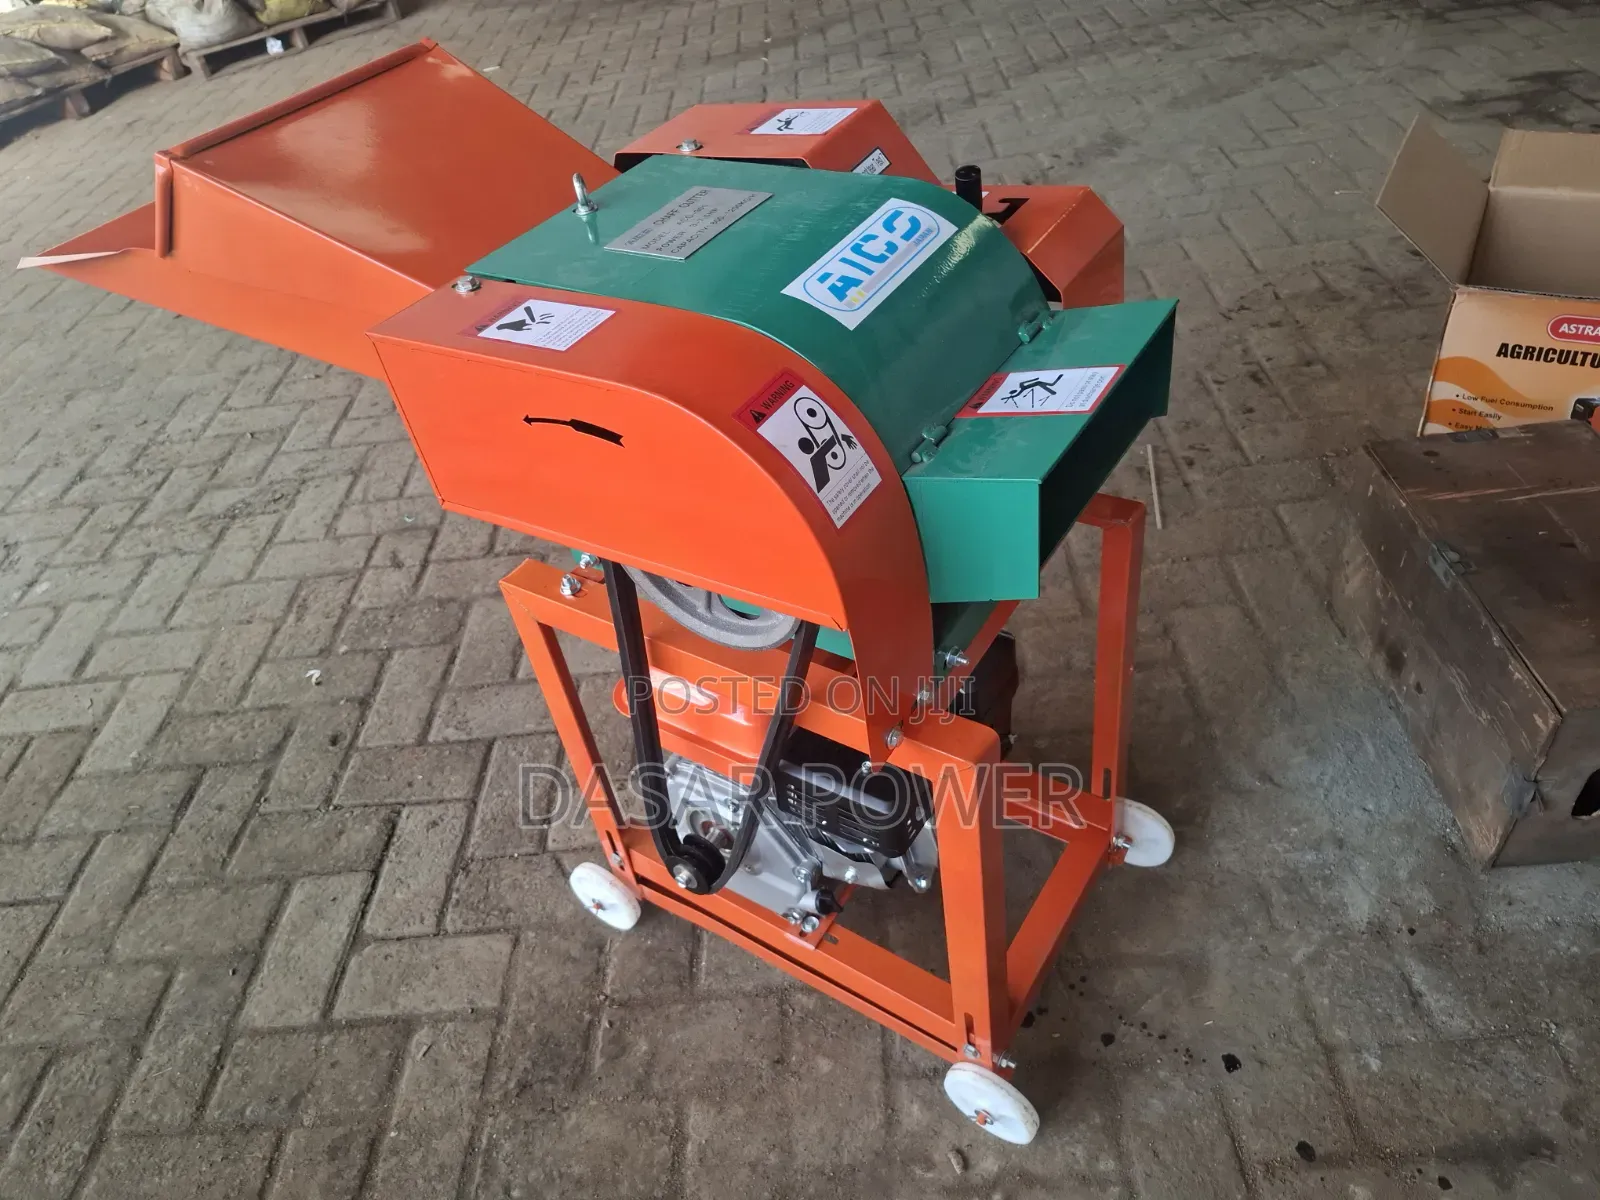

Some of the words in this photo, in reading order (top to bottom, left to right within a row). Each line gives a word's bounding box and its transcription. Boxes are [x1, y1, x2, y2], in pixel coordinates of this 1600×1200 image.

[653, 209, 679, 226] CHAFF
[679, 189, 709, 208] CUTTER
[760, 380, 795, 410] WARNING
[1462, 393, 1478, 401] Low
[1481, 396, 1498, 404] Fuel
[1499, 398, 1554, 412] Consumption
[1458, 408, 1477, 416] Start
[1478, 411, 1502, 421] Easily
[1455, 422, 1473, 430] Easy
